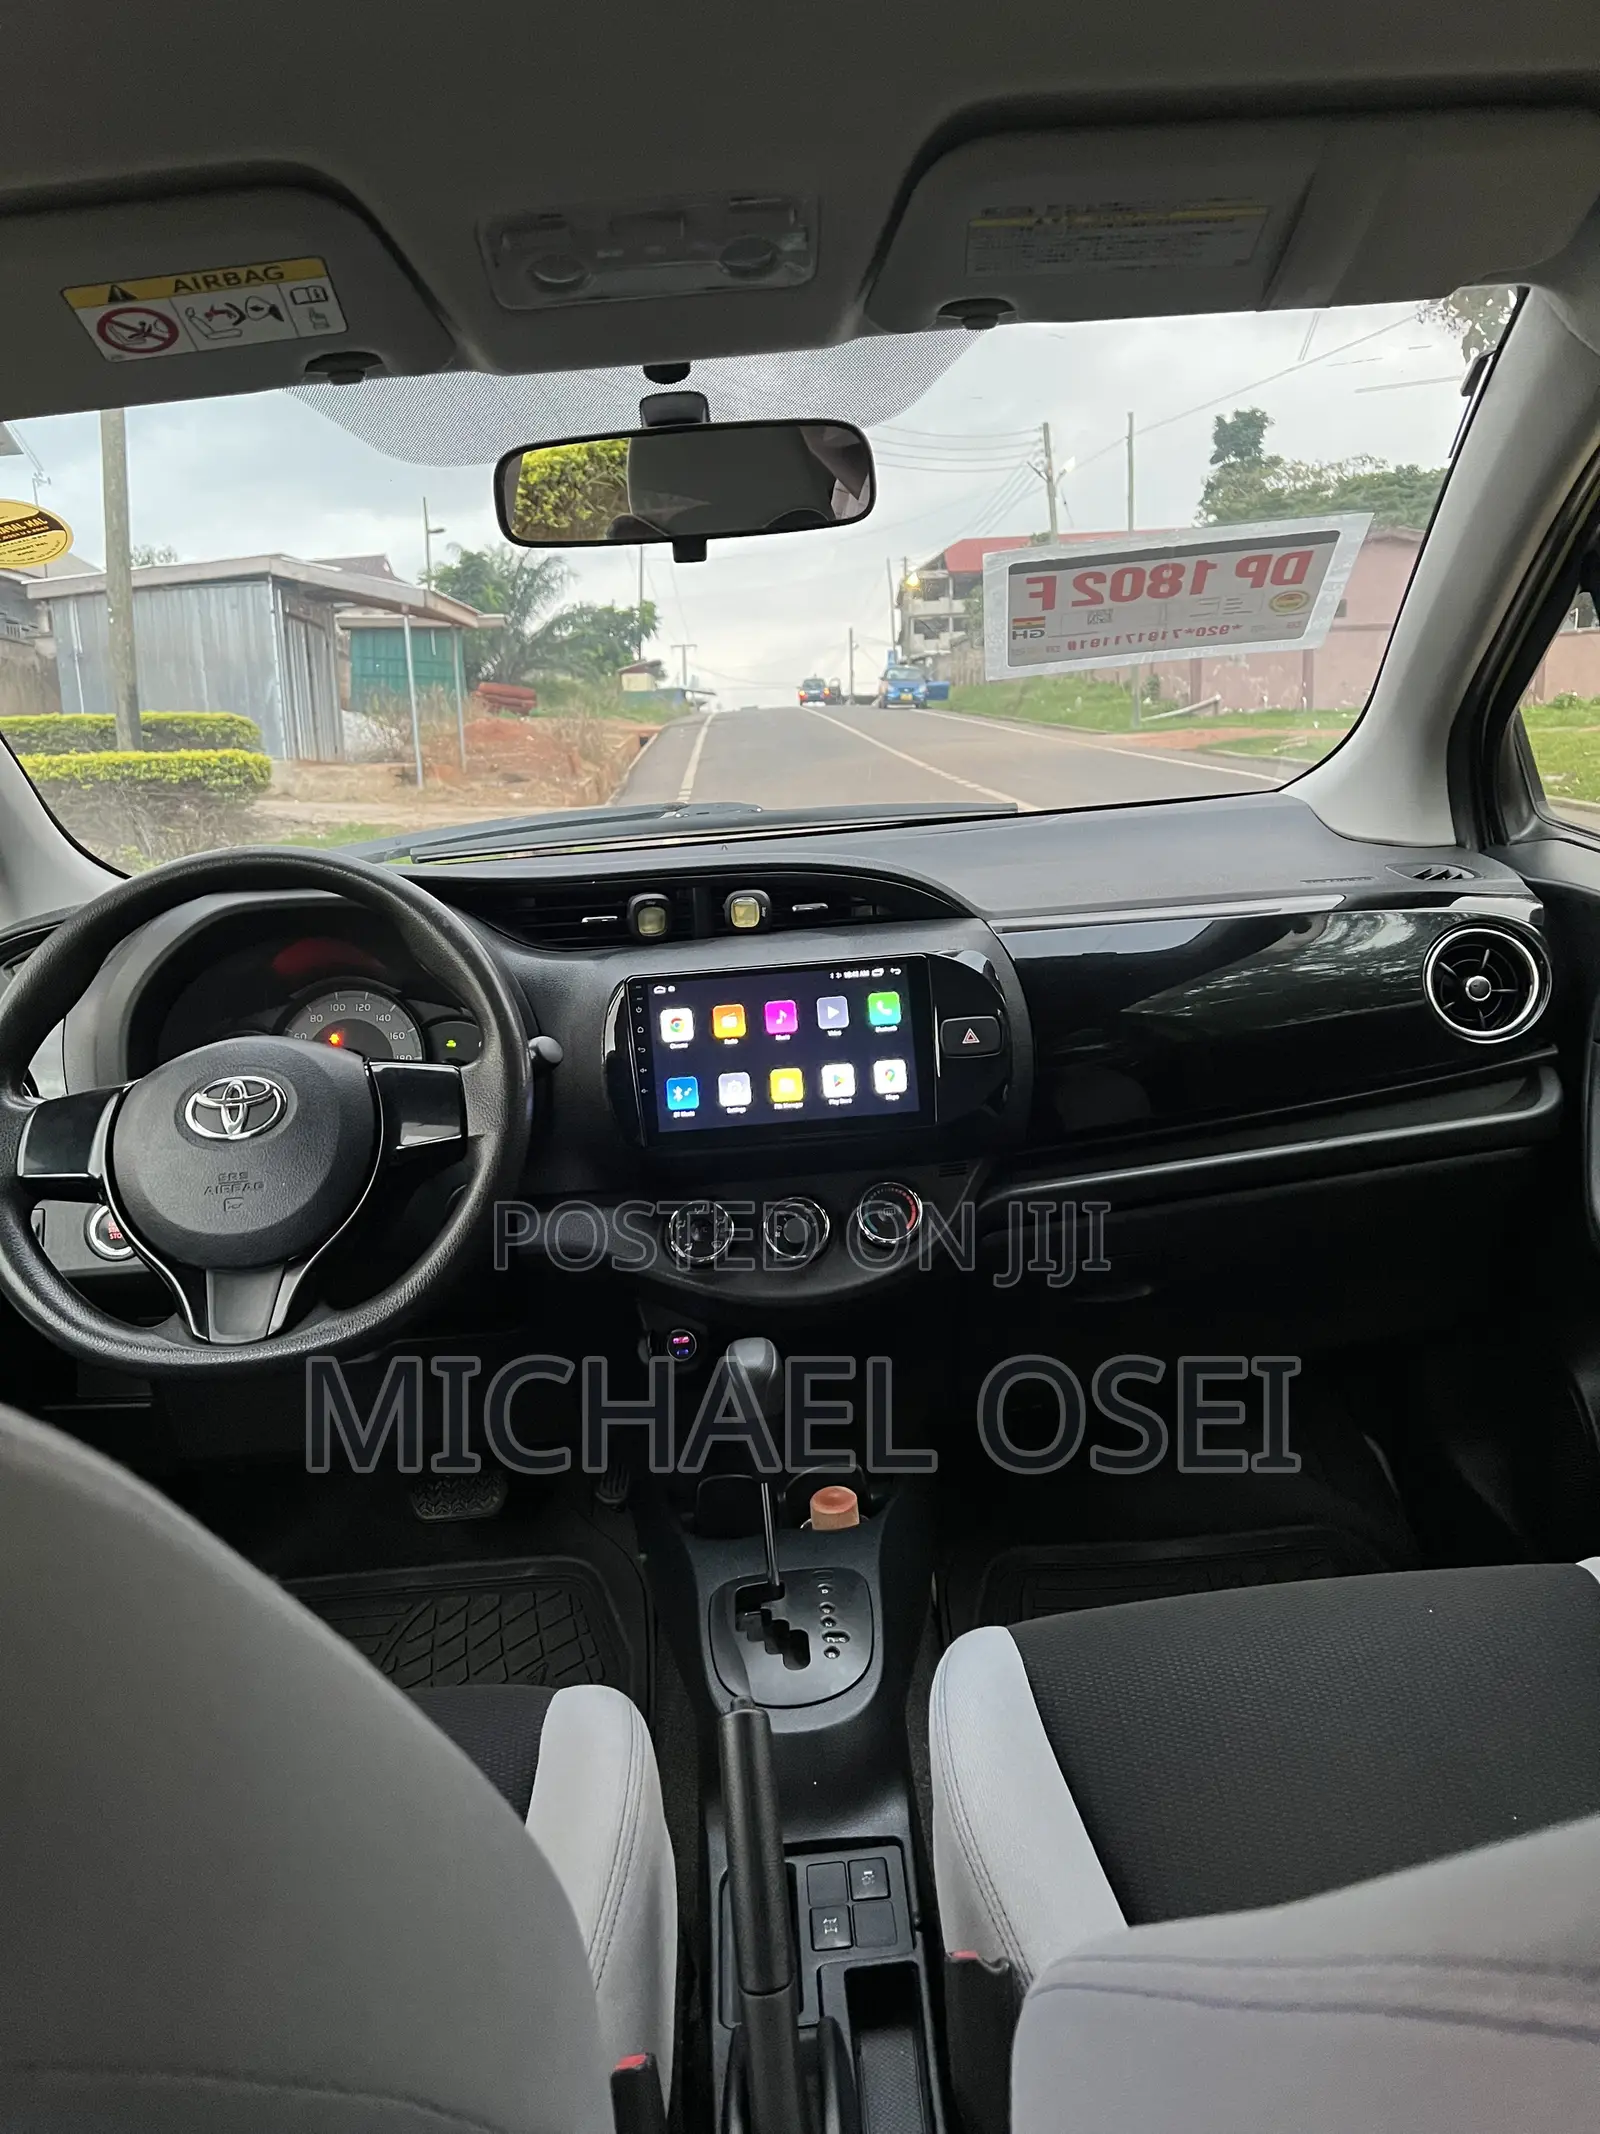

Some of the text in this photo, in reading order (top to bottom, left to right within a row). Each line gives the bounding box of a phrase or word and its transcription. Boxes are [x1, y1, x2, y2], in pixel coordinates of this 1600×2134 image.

[173, 265, 284, 293] AIRBAG
[329, 1003, 346, 1012] 100
[355, 1003, 371, 1012] 120
[309, 1014, 323, 1023] 80
[375, 1014, 392, 1022] 140
[389, 1032, 405, 1040] 160
